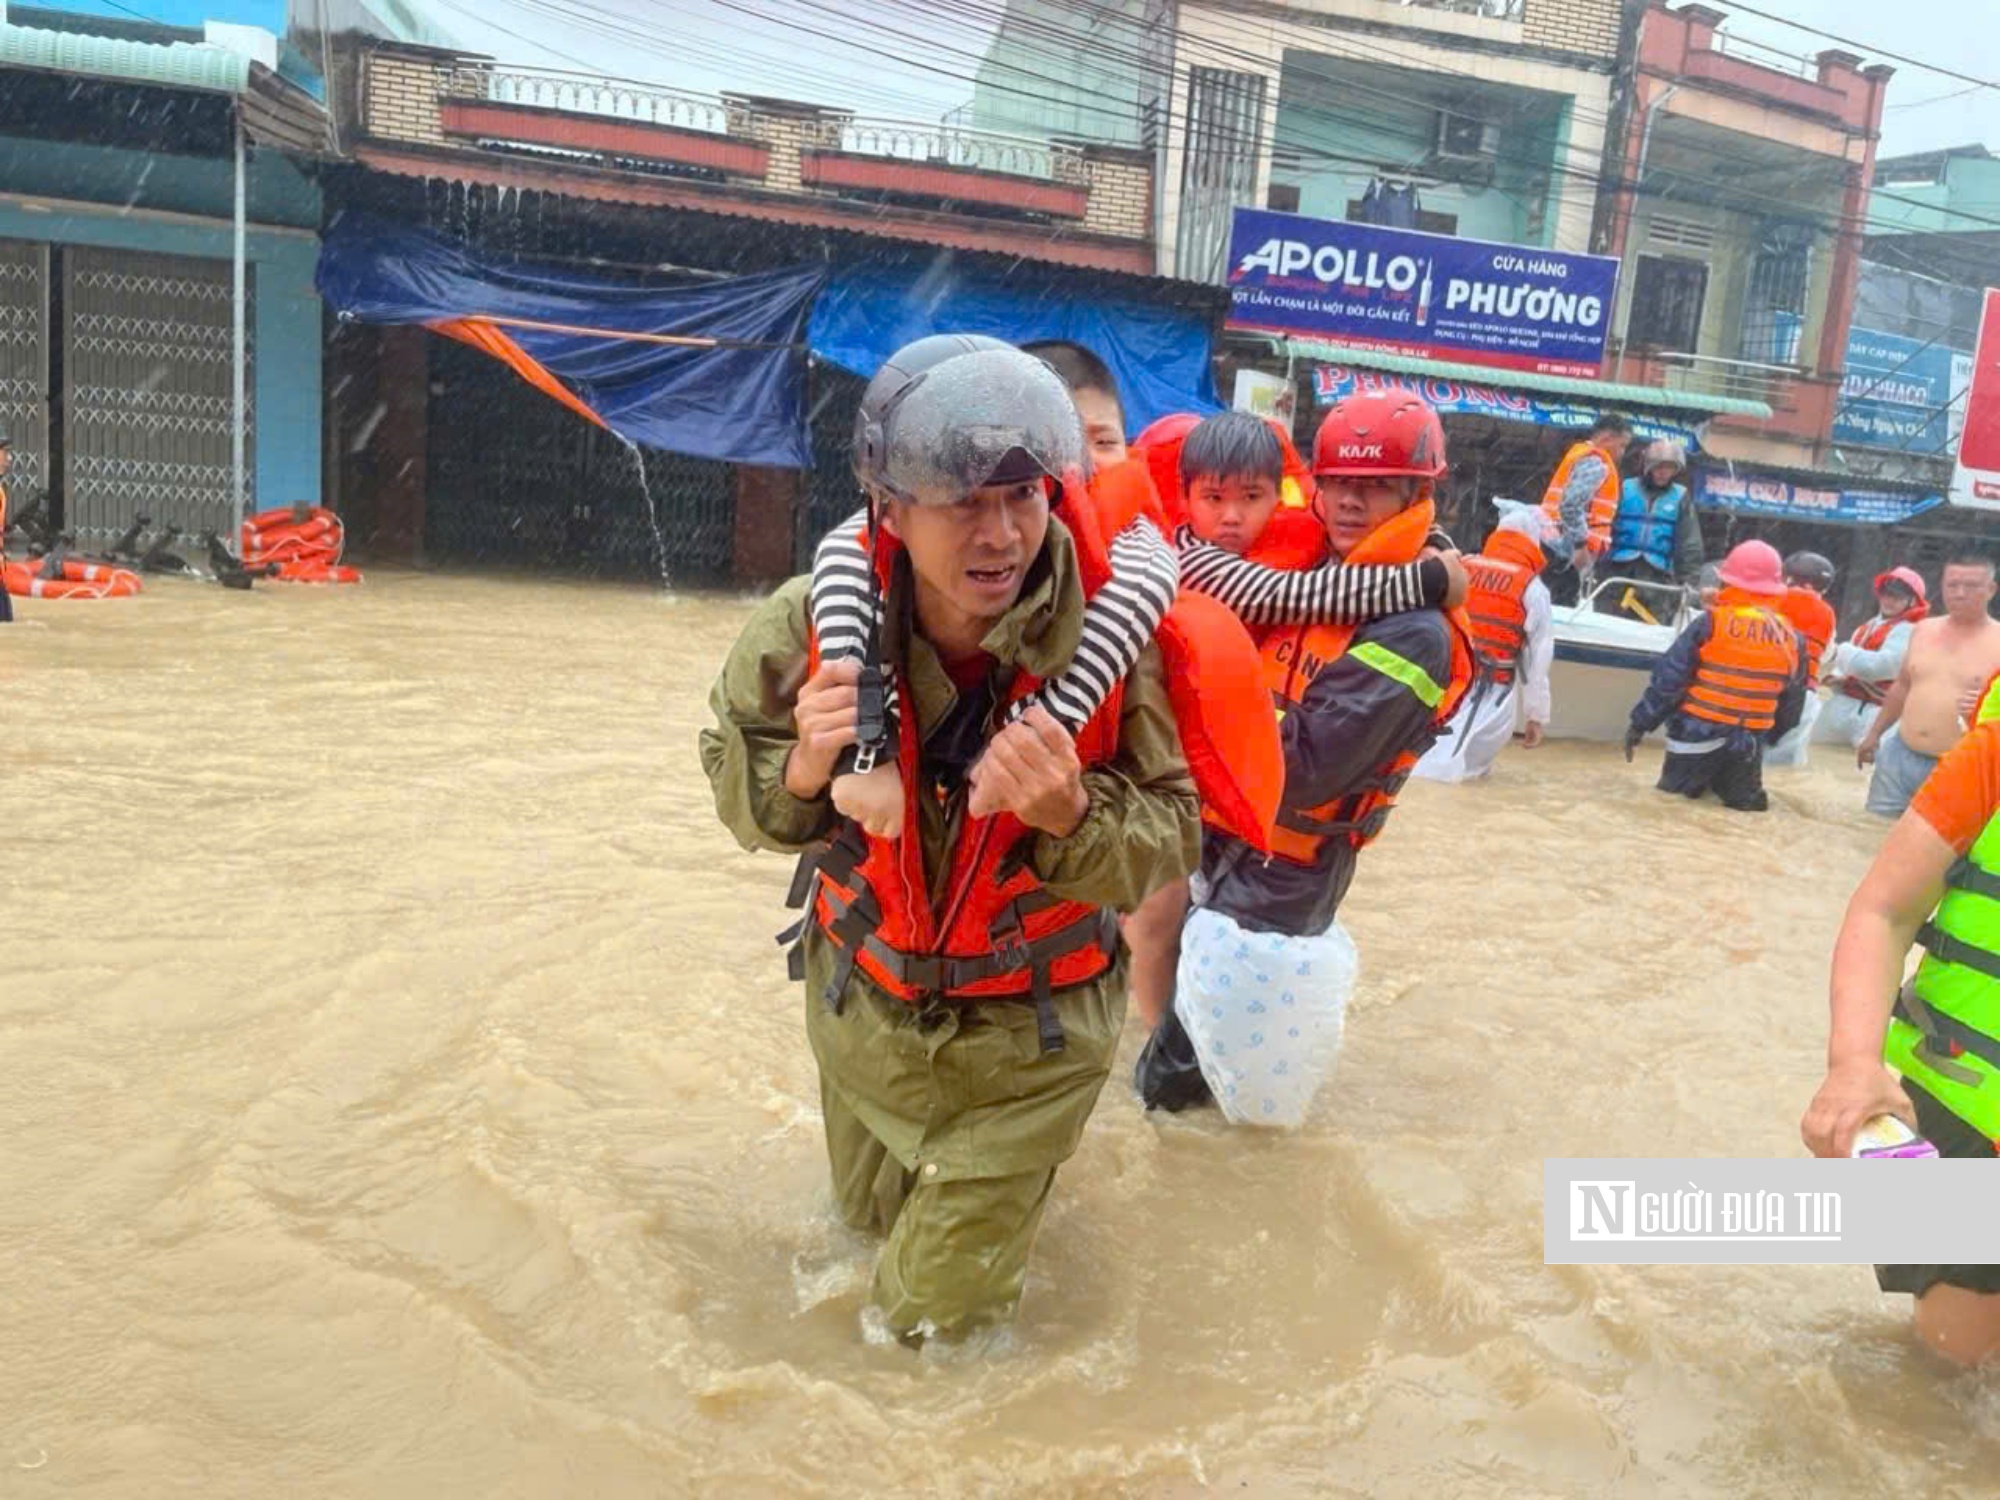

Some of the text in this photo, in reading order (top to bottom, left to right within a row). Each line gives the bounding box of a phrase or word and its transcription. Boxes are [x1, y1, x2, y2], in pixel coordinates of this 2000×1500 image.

[1239, 238, 1417, 292] APOLLO
[1492, 253, 1567, 277] CỬA HÀNG
[1446, 278, 1601, 327] PHƯƠNG
[1339, 443, 1384, 460] KASK
[1467, 567, 1514, 593] AND
